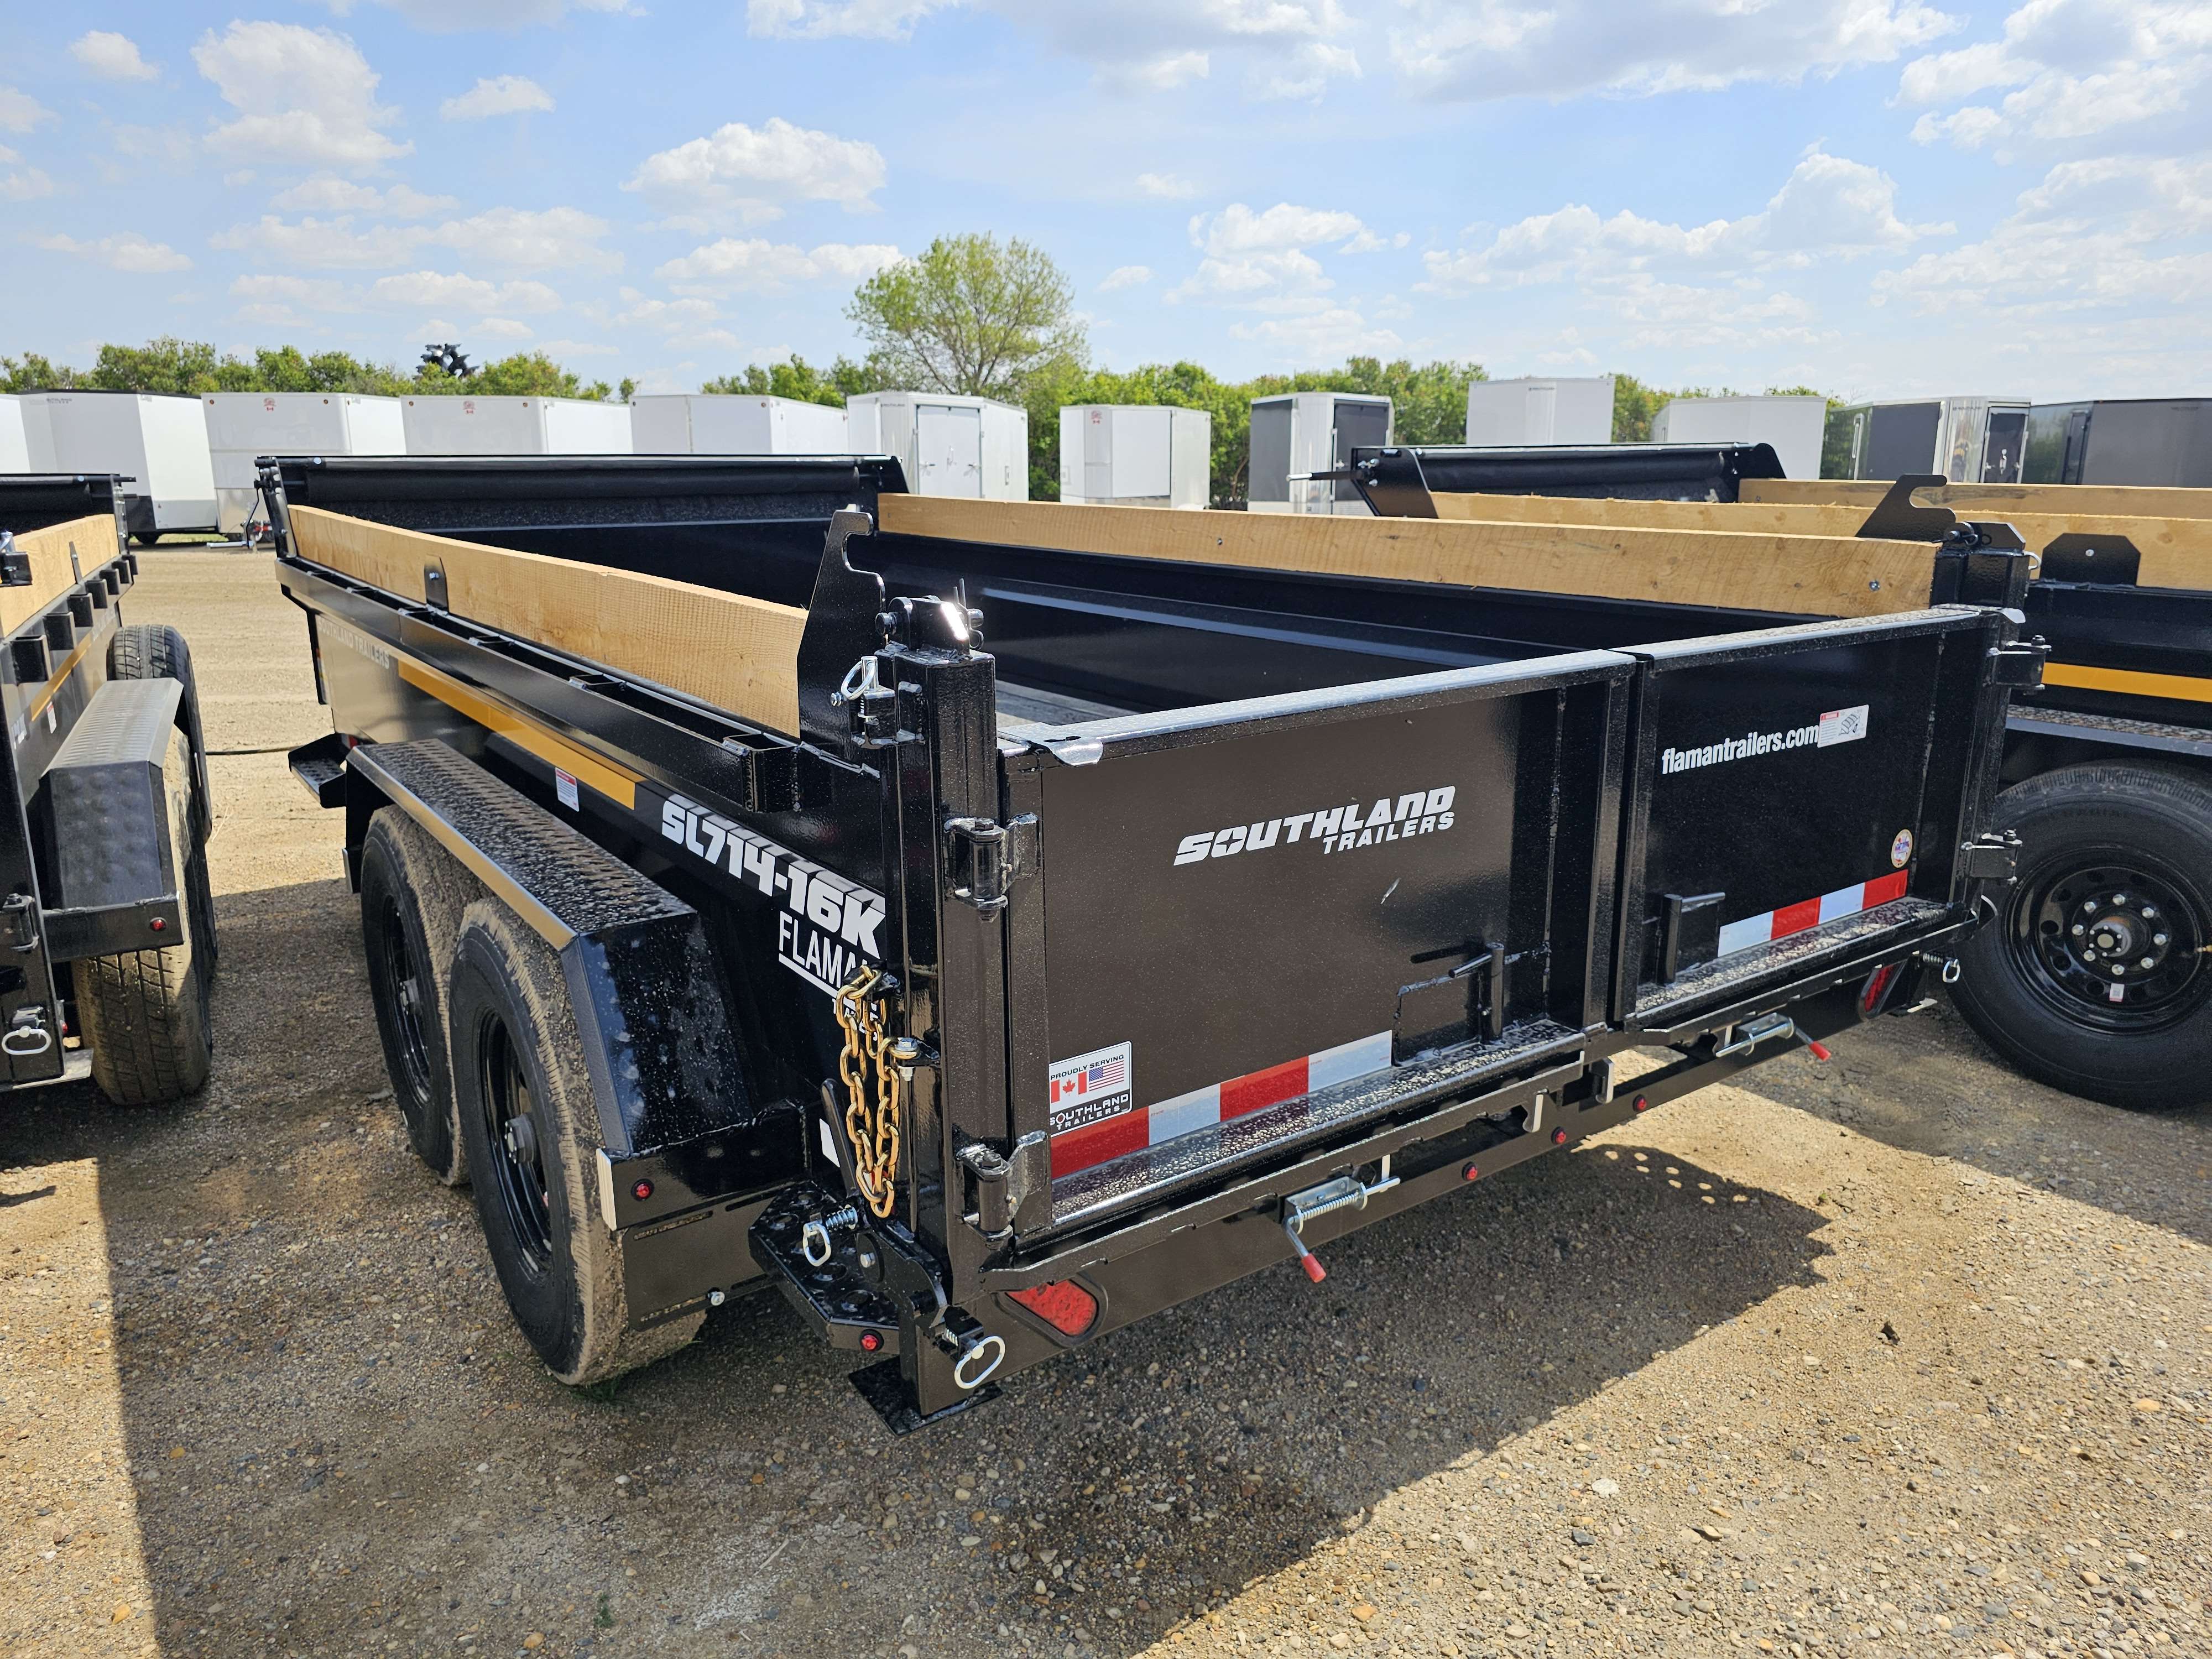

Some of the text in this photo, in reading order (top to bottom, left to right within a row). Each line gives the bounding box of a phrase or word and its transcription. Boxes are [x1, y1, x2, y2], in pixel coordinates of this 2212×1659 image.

[317, 616, 390, 669] SOUTHLAND TRAILERS
[1661, 724, 1819, 775] flamantrailers.com
[1173, 785, 1455, 866] SOUTHLAND
[1323, 811, 1454, 854] TRAILERS
[661, 793, 886, 959] SL714-16K
[1050, 1054, 1124, 1081] PROUDLY SERVING
[1050, 1093, 1129, 1126] SOUTHLAND
[1056, 1105, 1120, 1130] TRAILERS
